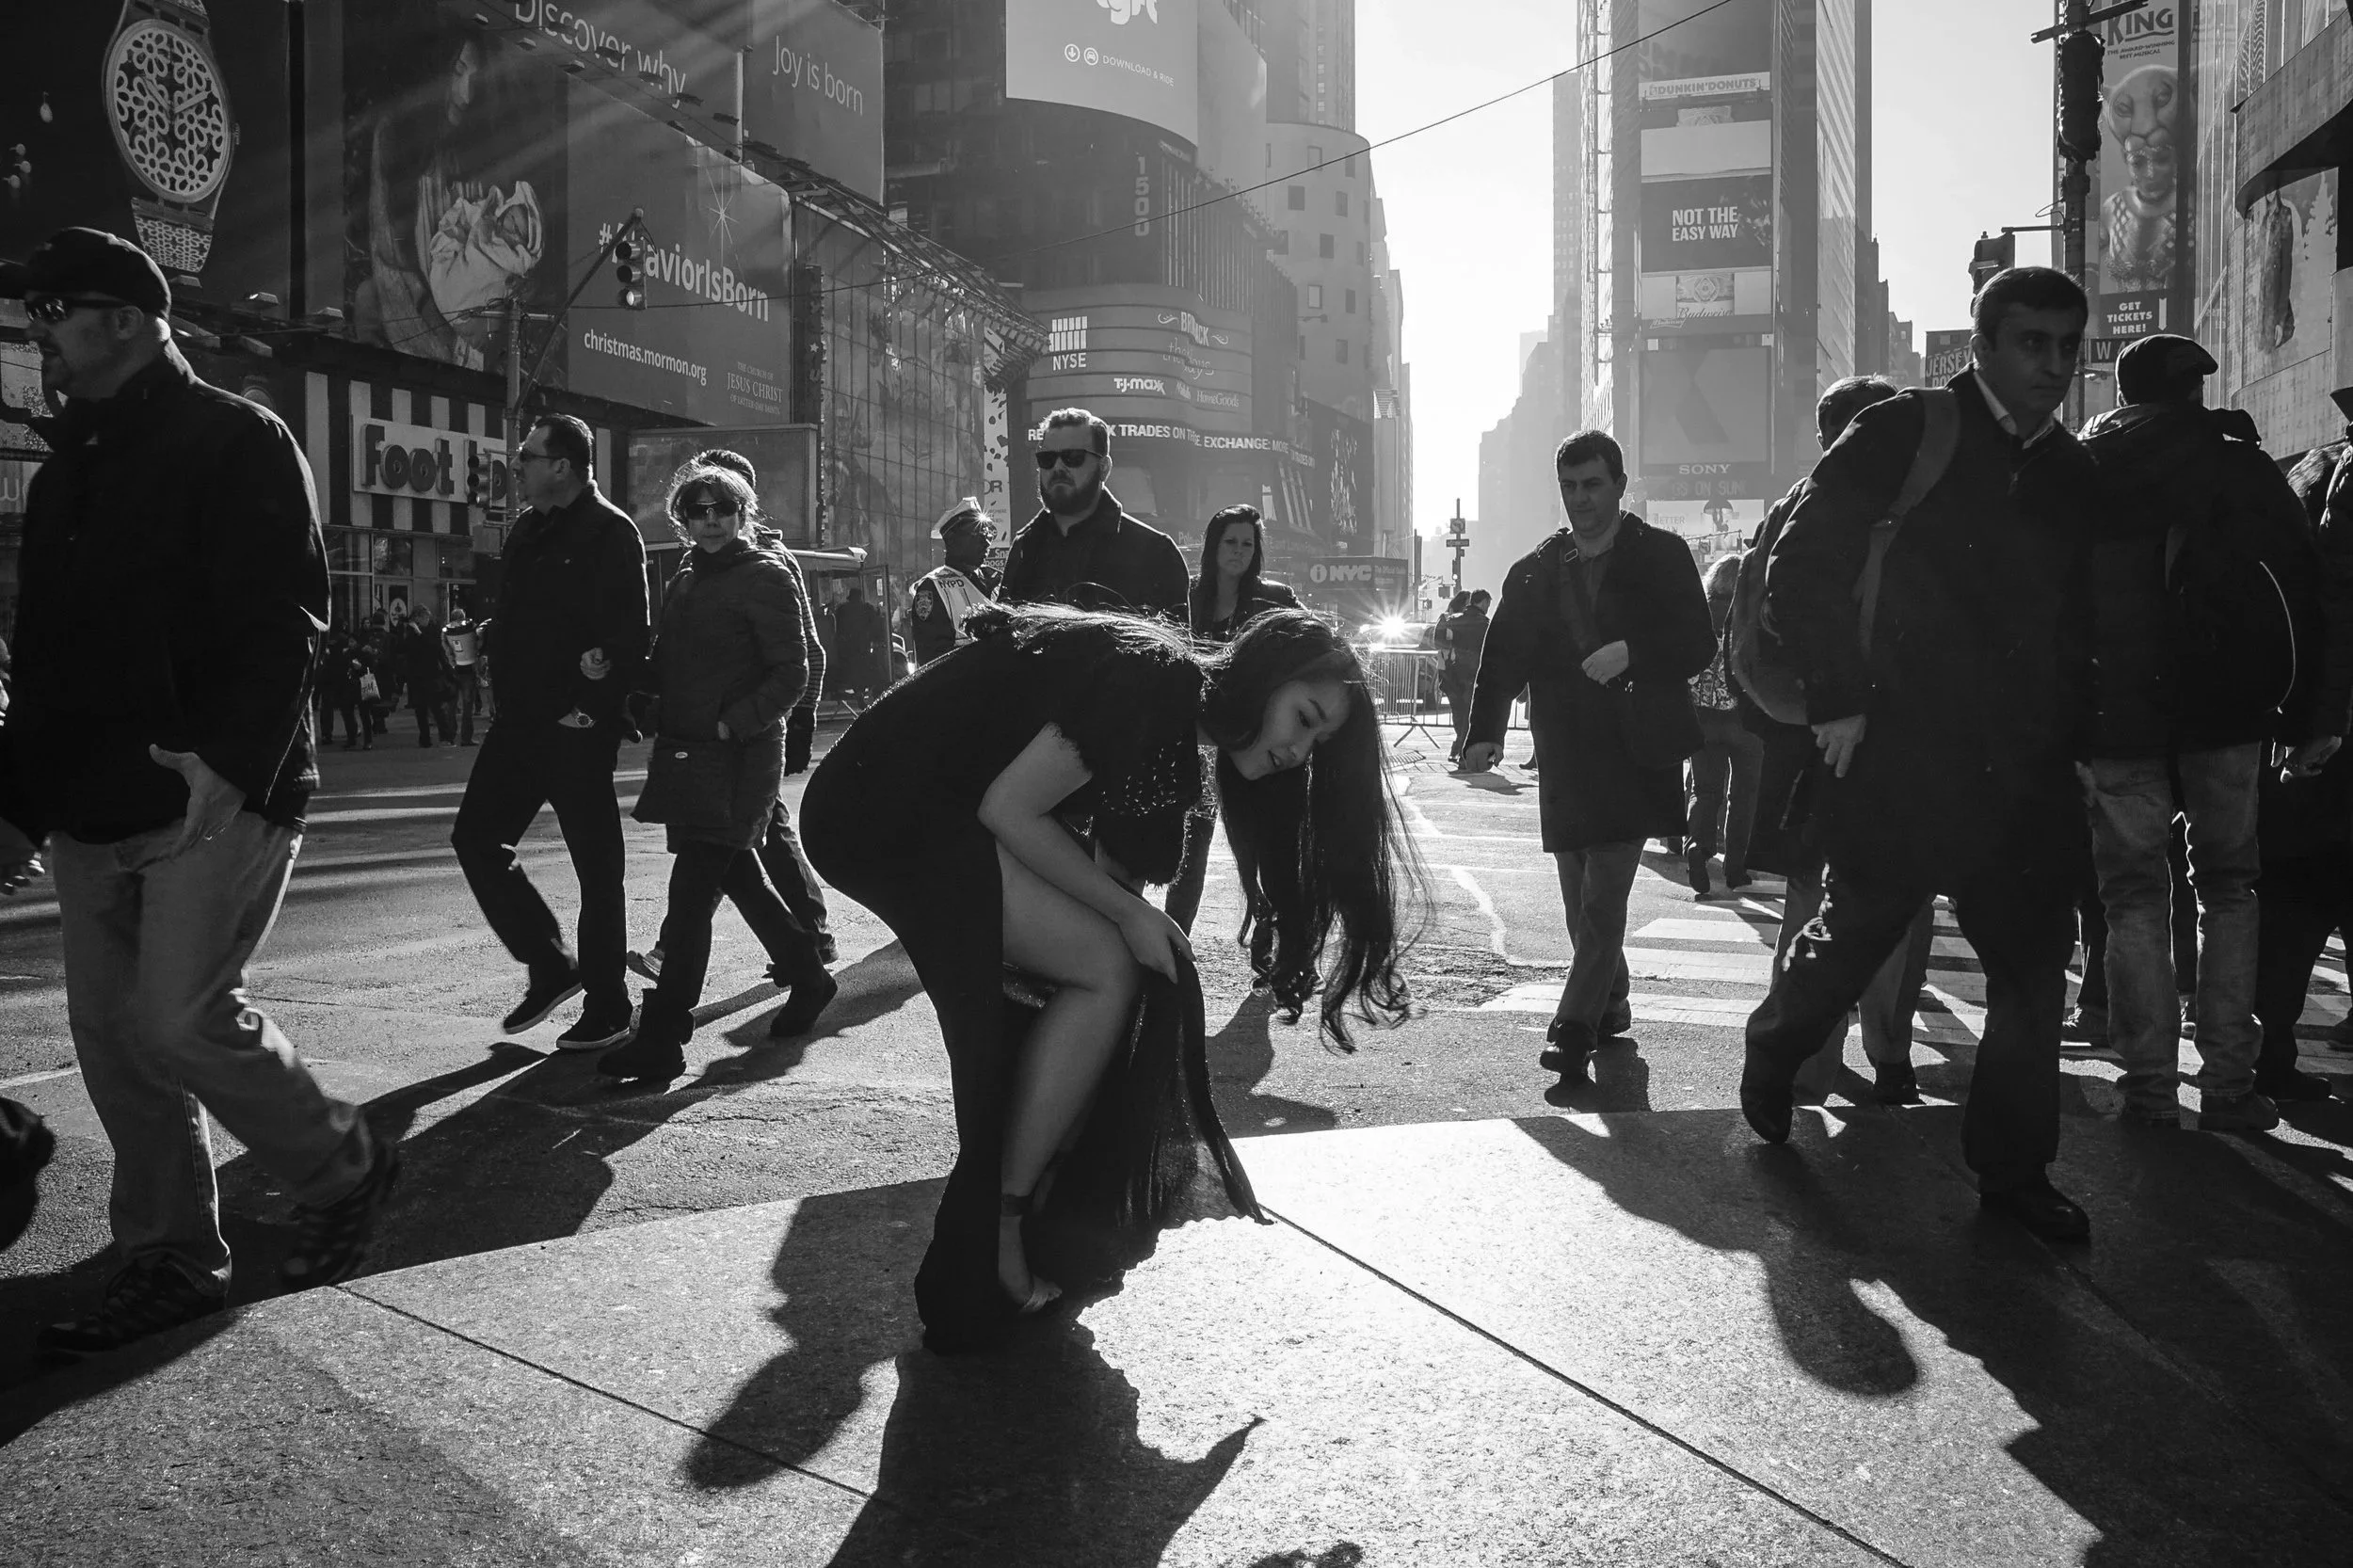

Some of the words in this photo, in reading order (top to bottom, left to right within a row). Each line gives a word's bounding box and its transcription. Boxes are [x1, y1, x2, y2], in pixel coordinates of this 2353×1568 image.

[2107, 8, 2174, 47] KING
[514, 0, 632, 72] Discover
[637, 49, 687, 110] why
[772, 35, 806, 88] Joy
[806, 52, 822, 90] is
[824, 62, 865, 117] born
[1102, 55, 1151, 76] DOWNLOAD
[1153, 71, 1159, 79] &
[1160, 73, 1175, 88] RIDE
[1134, 156, 1150, 236] 1500
[1673, 208, 1705, 226] NOT
[1707, 206, 1738, 224] THE
[1672, 226, 1706, 242] EASY
[1708, 224, 1738, 239] WAY
[2119, 301, 2142, 312] GET
[2106, 312, 2153, 323] TICKETS
[2112, 324, 2147, 335] HERE!
[584, 329, 707, 386] christmas.mormon.org
[2096, 341, 2112, 359] W
[1052, 352, 1087, 371] NYSE
[1926, 345, 1974, 377] JERSEY
[727, 372, 751, 394] JESUS
[752, 381, 783, 404] CHRIST
[1196, 390, 1240, 408] HomeGoods
[1118, 424, 1172, 439] TRADES
[1173, 425, 1187, 440] ON
[1678, 464, 1732, 474] SONY
[1329, 565, 1372, 582] NYC
[937, 579, 965, 589] NYPD
